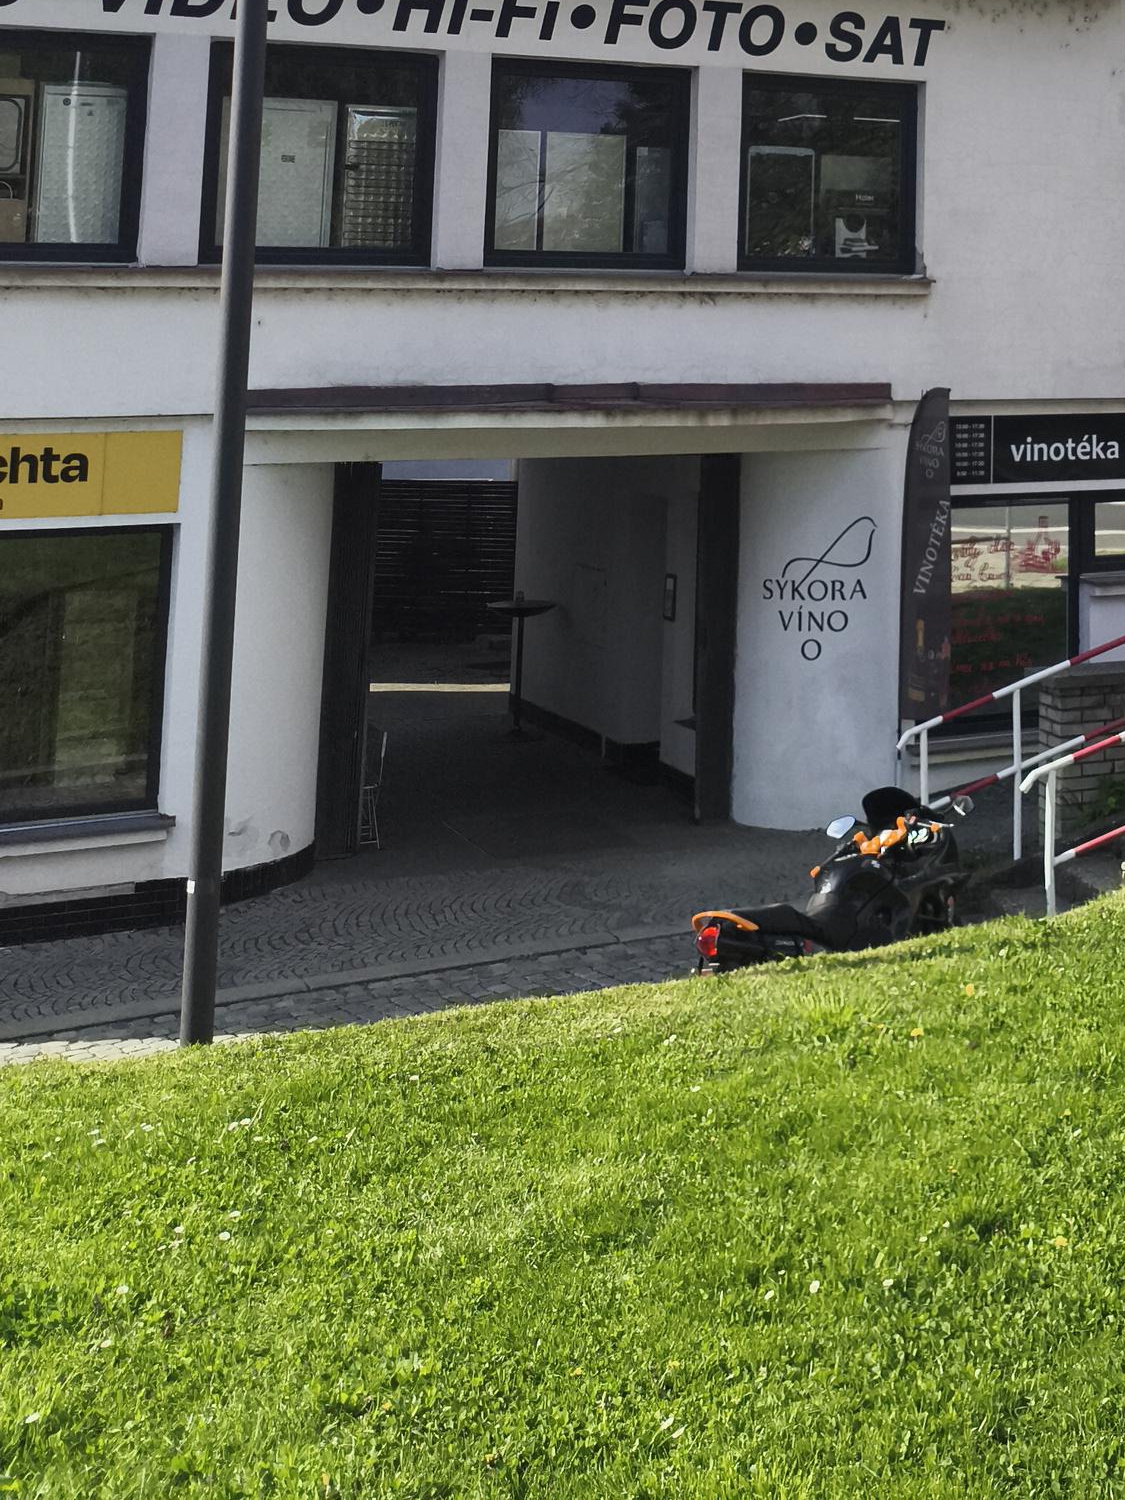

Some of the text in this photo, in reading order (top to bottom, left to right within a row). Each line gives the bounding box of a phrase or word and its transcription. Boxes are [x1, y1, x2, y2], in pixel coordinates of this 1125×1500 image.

[825, 11, 946, 68] SAT
[1010, 434, 1120, 463] vinotéka
[913, 499, 950, 595] VINOTÉKA
[778, 605, 849, 632] VÍNO
[801, 638, 822, 661] O
